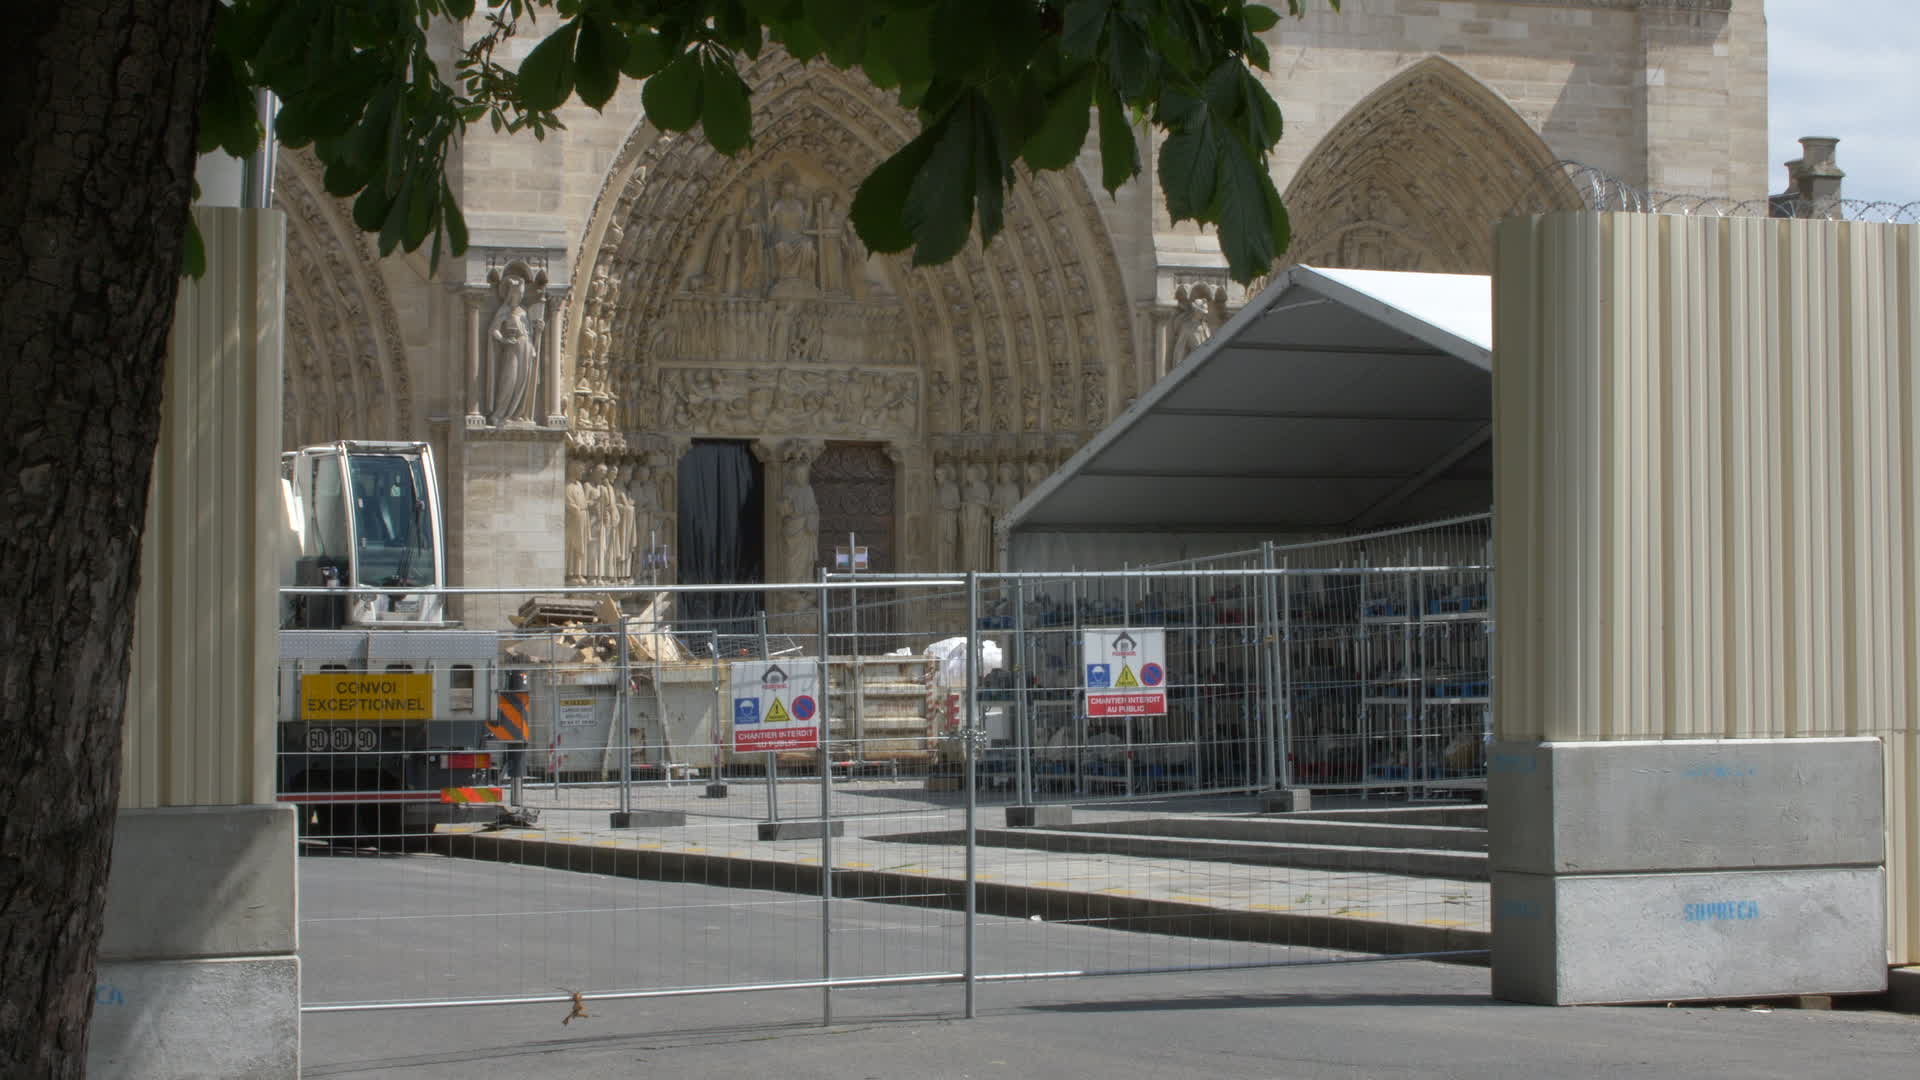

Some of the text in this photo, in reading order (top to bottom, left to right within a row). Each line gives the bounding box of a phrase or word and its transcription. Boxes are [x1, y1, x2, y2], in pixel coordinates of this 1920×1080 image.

[336, 681, 397, 694] CONVOI
[307, 698, 425, 712] EXCEPTIONNEL
[311, 730, 374, 748] 60 80 90
[738, 730, 813, 740] CHANTIER INTERDIT
